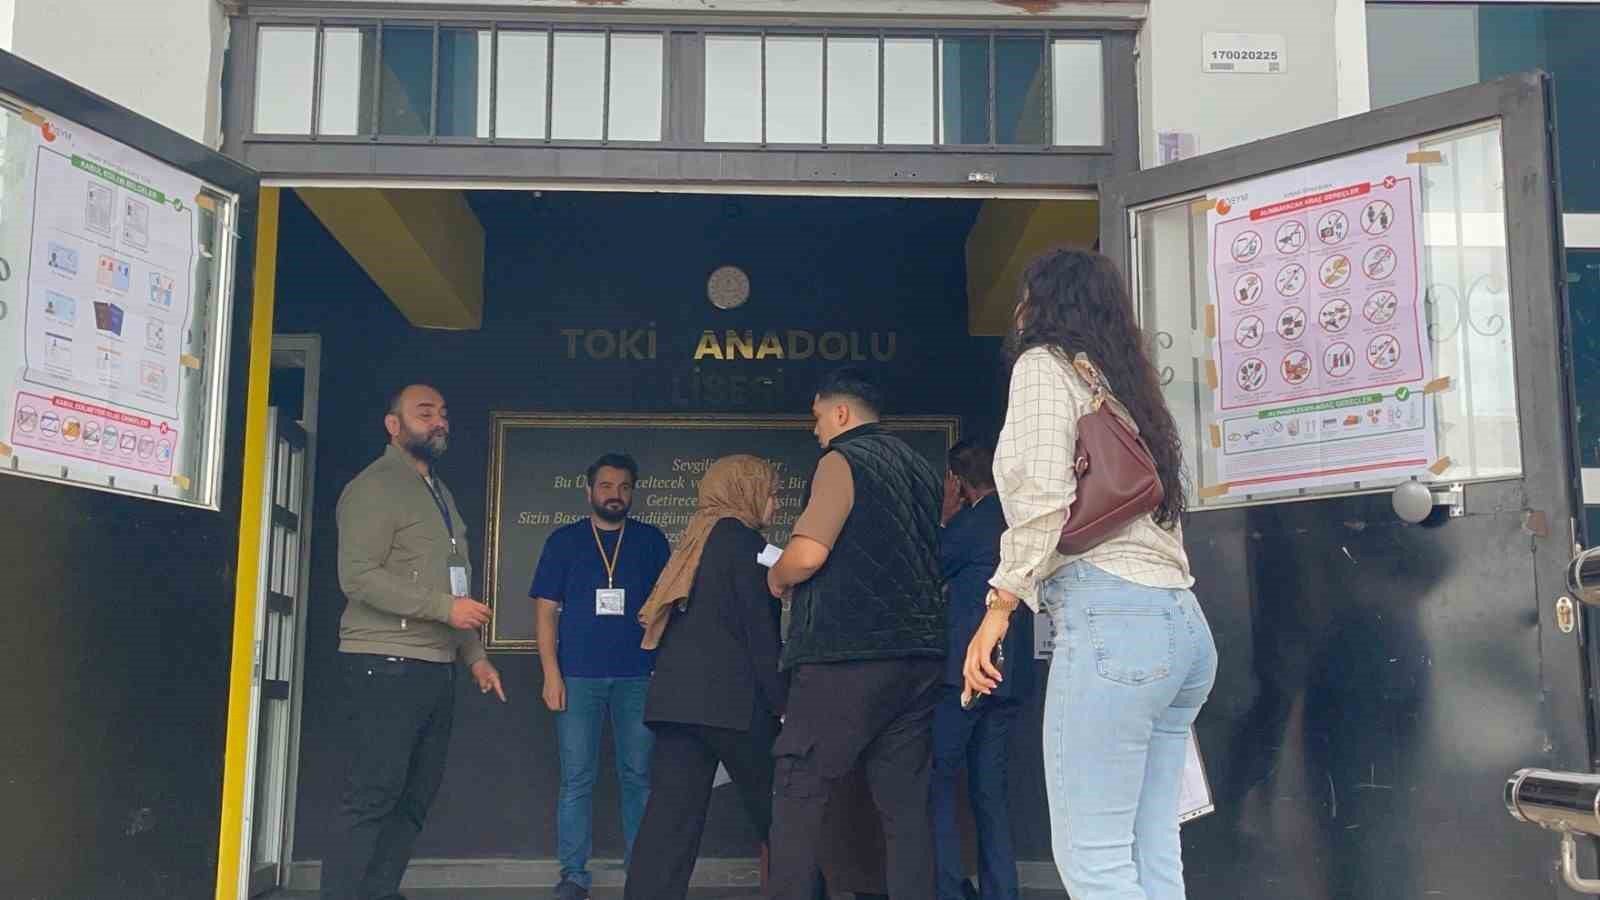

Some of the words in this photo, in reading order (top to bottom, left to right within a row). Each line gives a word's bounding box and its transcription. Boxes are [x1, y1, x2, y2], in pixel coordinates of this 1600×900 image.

[1211, 50, 1278, 60] 170020225
[560, 321, 656, 360] TOKİ
[693, 329, 896, 361] ANADOLU
[553, 476, 571, 488] Bu
[518, 512, 549, 524] Sizin
